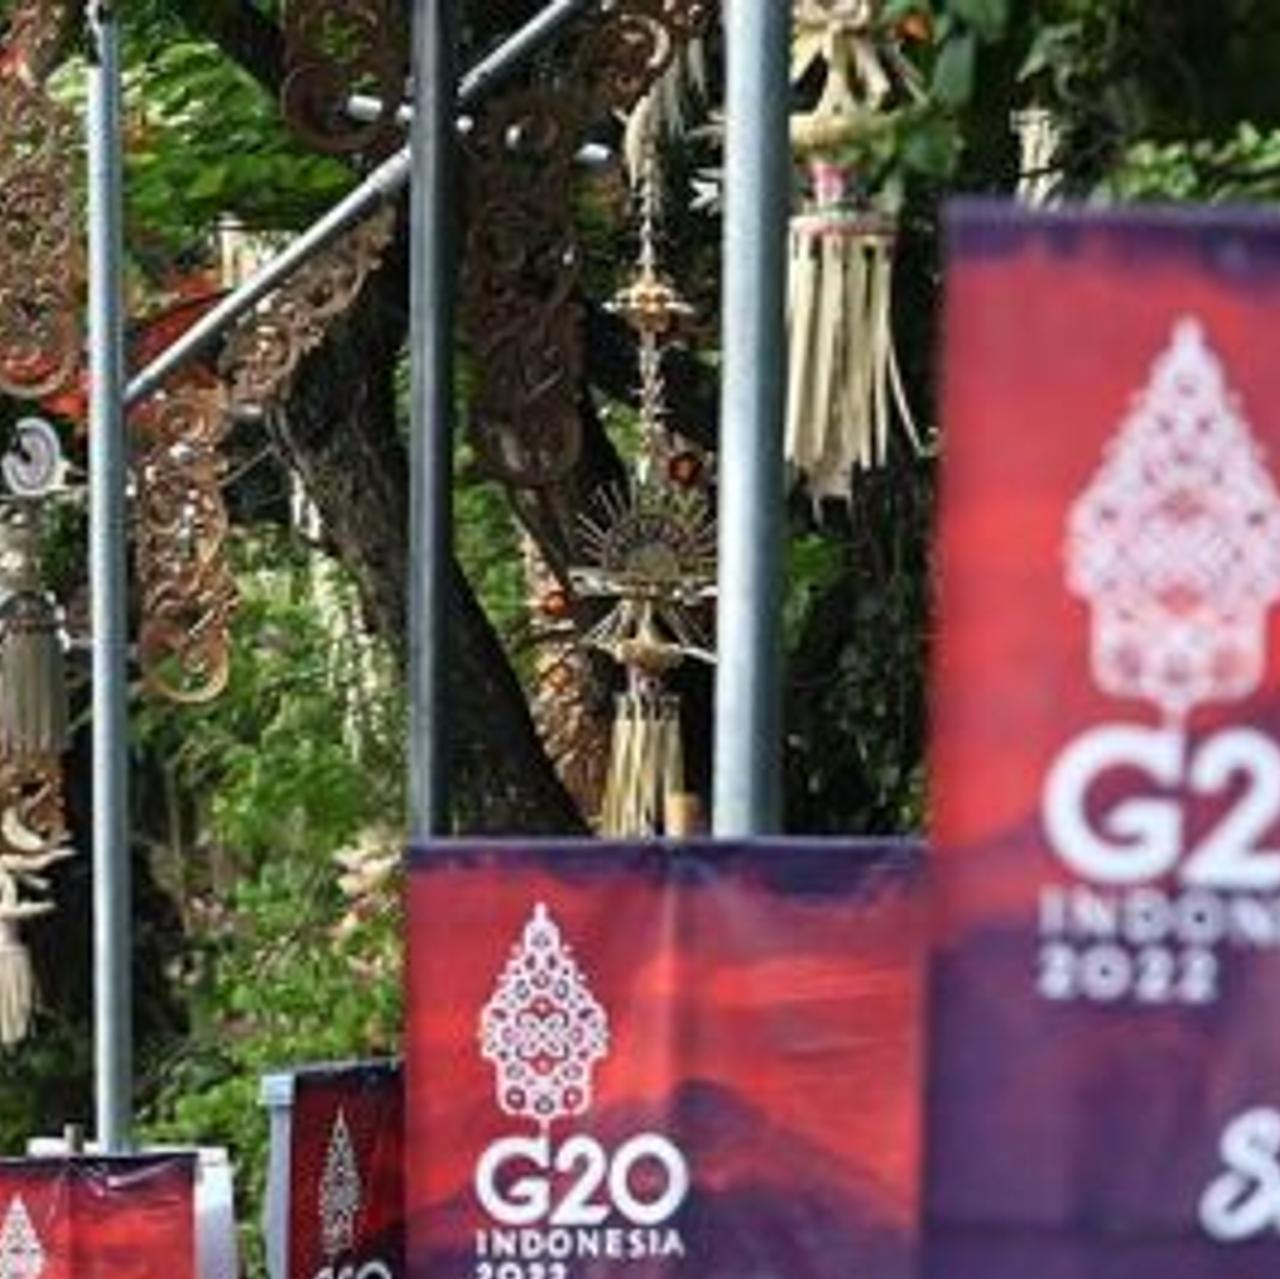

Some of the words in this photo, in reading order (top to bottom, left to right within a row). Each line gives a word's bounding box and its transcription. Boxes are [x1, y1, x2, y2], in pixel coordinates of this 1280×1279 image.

[1038, 943, 1219, 1001] 2022
[476, 1133, 689, 1225] G20
[475, 1228, 685, 1258] INDONESIA
